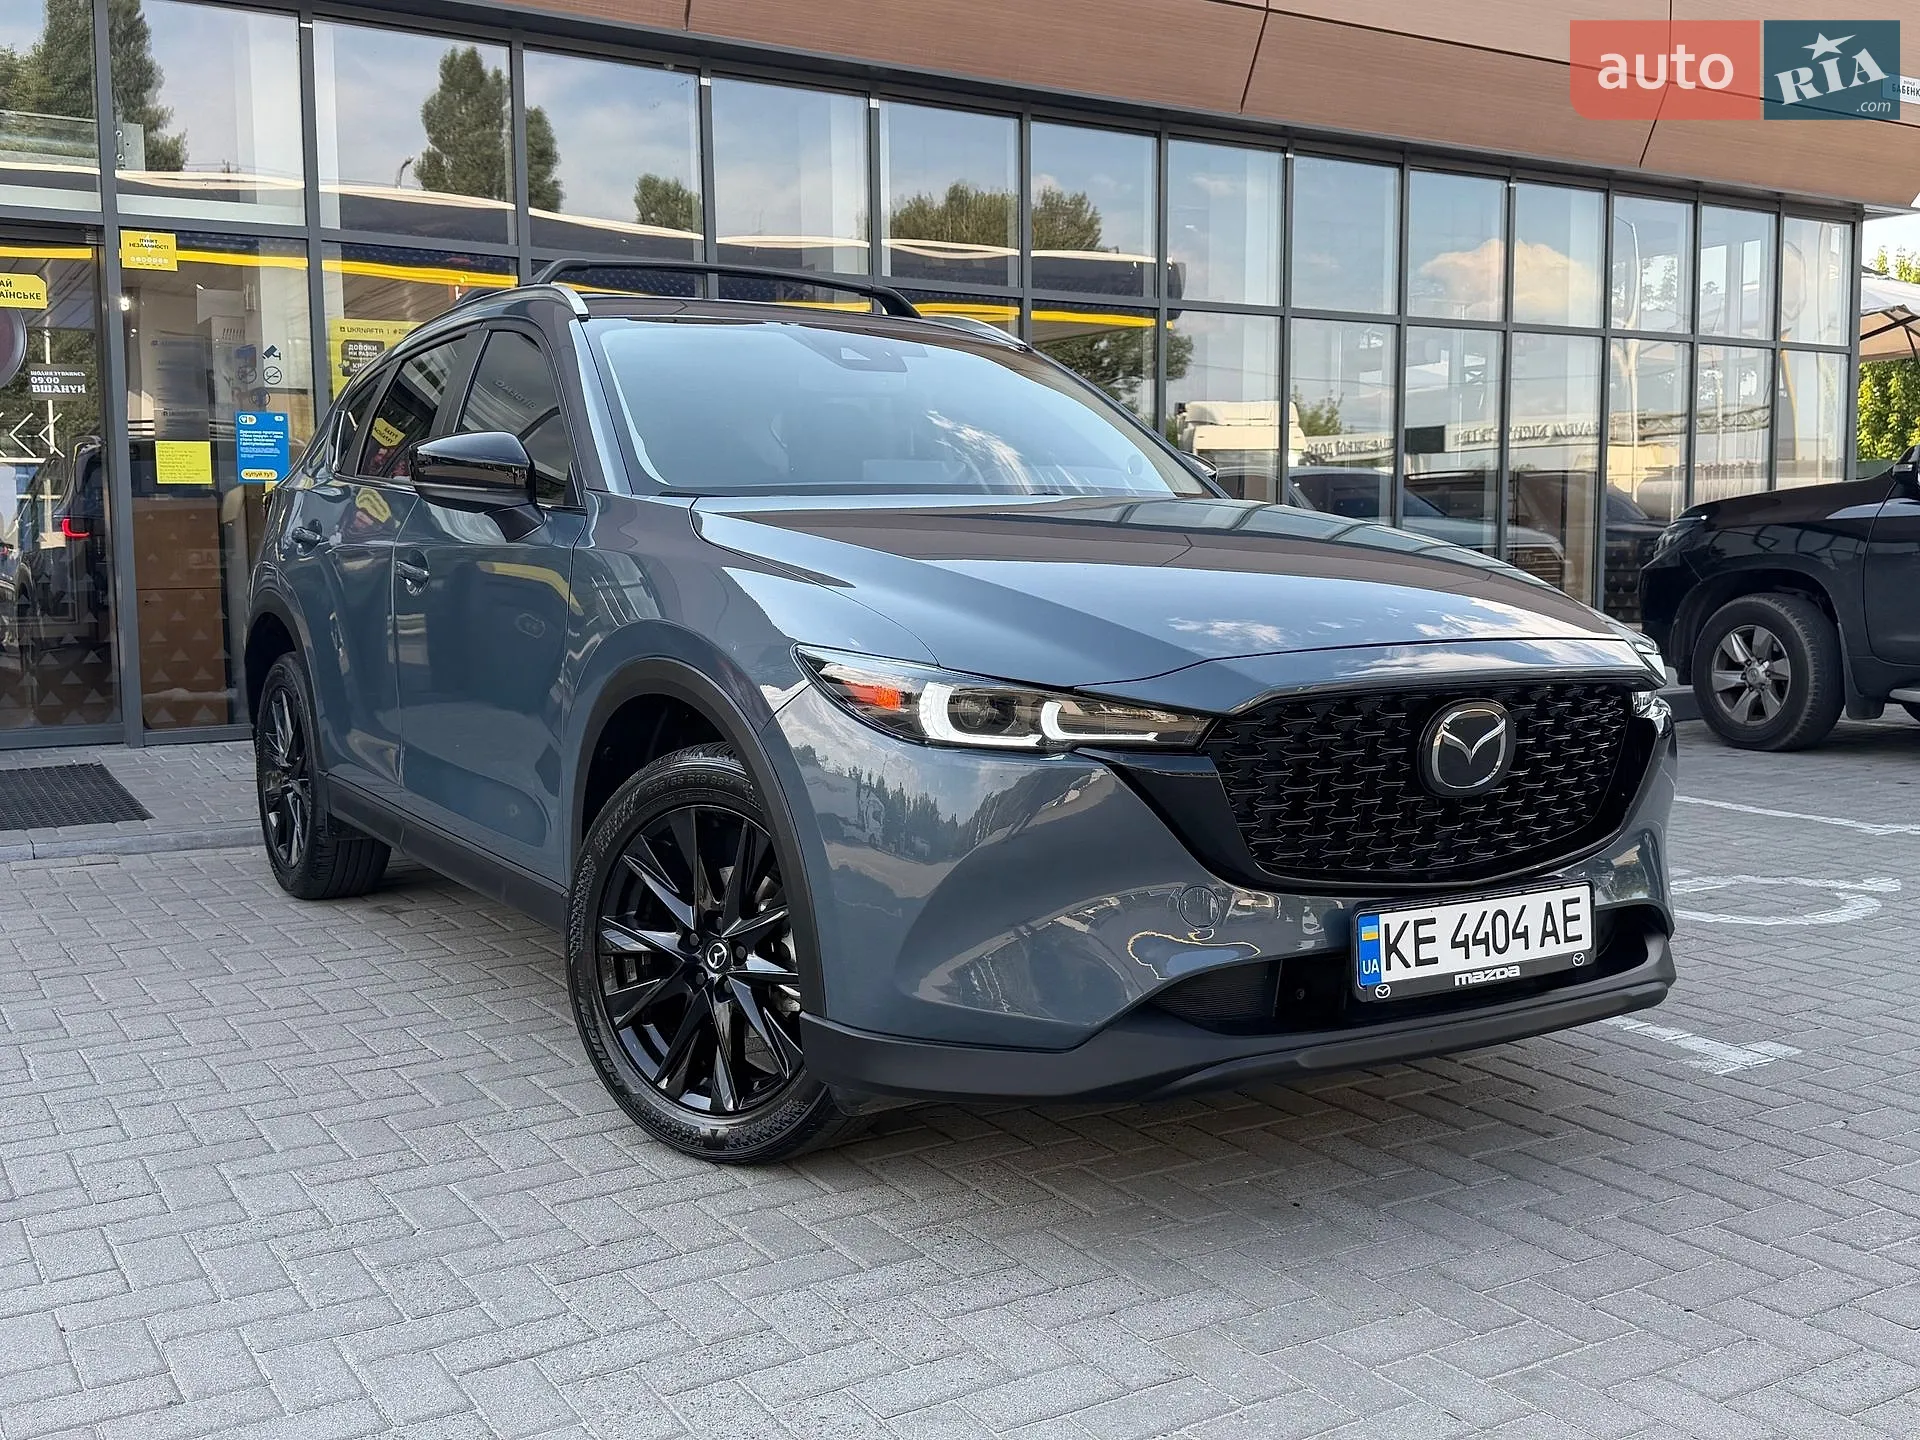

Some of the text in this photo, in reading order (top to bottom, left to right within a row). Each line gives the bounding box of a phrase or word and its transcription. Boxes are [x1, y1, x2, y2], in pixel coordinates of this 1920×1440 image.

[31, 383, 87, 393] ВШАНУЙ
[1384, 896, 1583, 971] KE 4404 AE
[1362, 960, 1380, 975] UA
[1454, 965, 1521, 987] mazda
